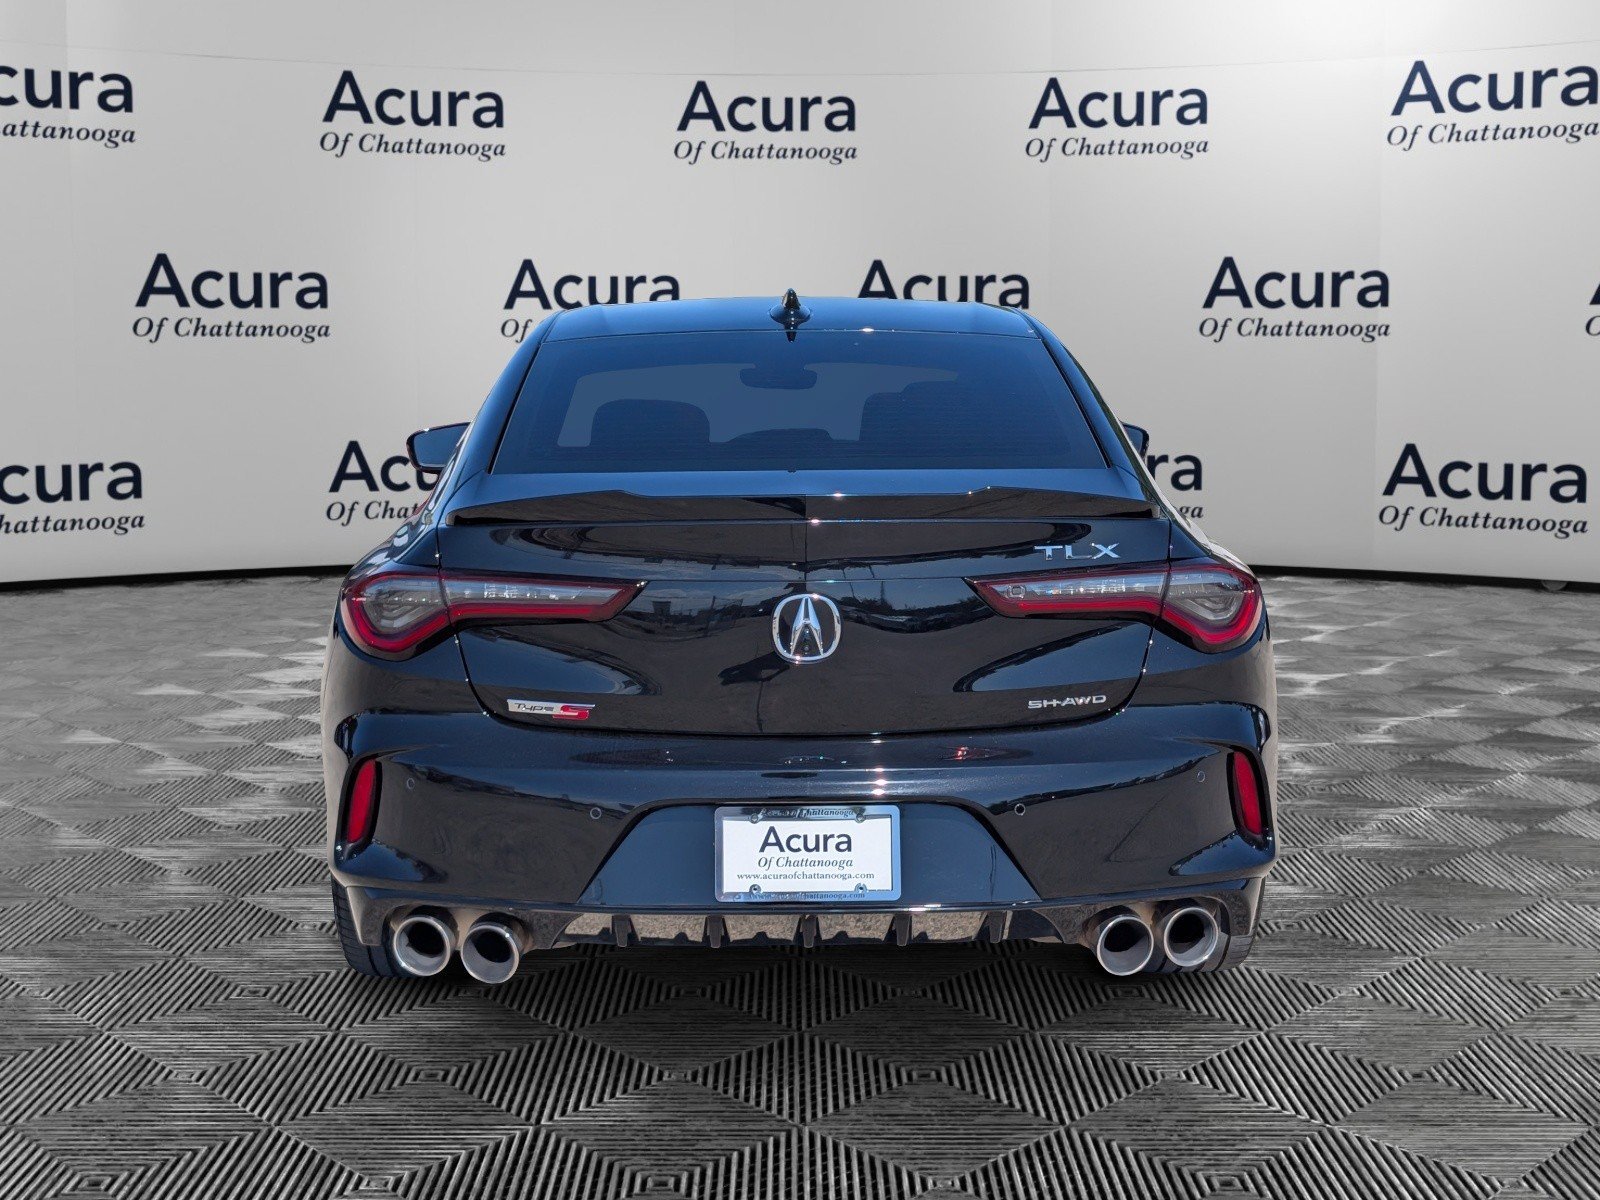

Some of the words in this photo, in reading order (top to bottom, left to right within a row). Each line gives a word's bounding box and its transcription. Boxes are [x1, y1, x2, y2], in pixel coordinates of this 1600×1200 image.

[0, 65, 133, 113] cura
[322, 70, 504, 129] Acura
[1390, 60, 1599, 116] Acura
[677, 80, 856, 133] Acura
[1028, 77, 1207, 130] Acura
[0, 120, 136, 149] attanooga
[320, 132, 353, 158] Of
[358, 133, 506, 162] Chattanooga
[1387, 125, 1423, 151] Of
[1428, 122, 1600, 144] Chattanooga
[674, 141, 706, 165] Of
[711, 141, 857, 165] Chattanooga
[1025, 138, 1057, 163] Of
[1061, 137, 1208, 159] Chattanooga
[135, 253, 328, 310] Acura
[503, 259, 680, 310] Acura
[858, 259, 1030, 309] Acura
[1202, 256, 1389, 309] Acura
[132, 317, 169, 343] Of
[174, 317, 331, 343] Chattanooga
[501, 318, 533, 343] Of
[1199, 318, 1233, 343] Of
[1237, 317, 1390, 343] Chattanooga
[0, 461, 142, 505] cura
[1382, 443, 1587, 503] Acura
[0, 514, 146, 536] hattanooga
[326, 501, 359, 527] Of
[1379, 505, 1415, 531] Of
[1419, 507, 1589, 539] Chattanooga
[1034, 543, 1121, 561] TLX
[759, 826, 852, 853] Acura
[737, 871, 875, 880] www.acuraofchattanooga.com
[758, 857, 774, 871] Of
[776, 857, 853, 871] Chattanooga
